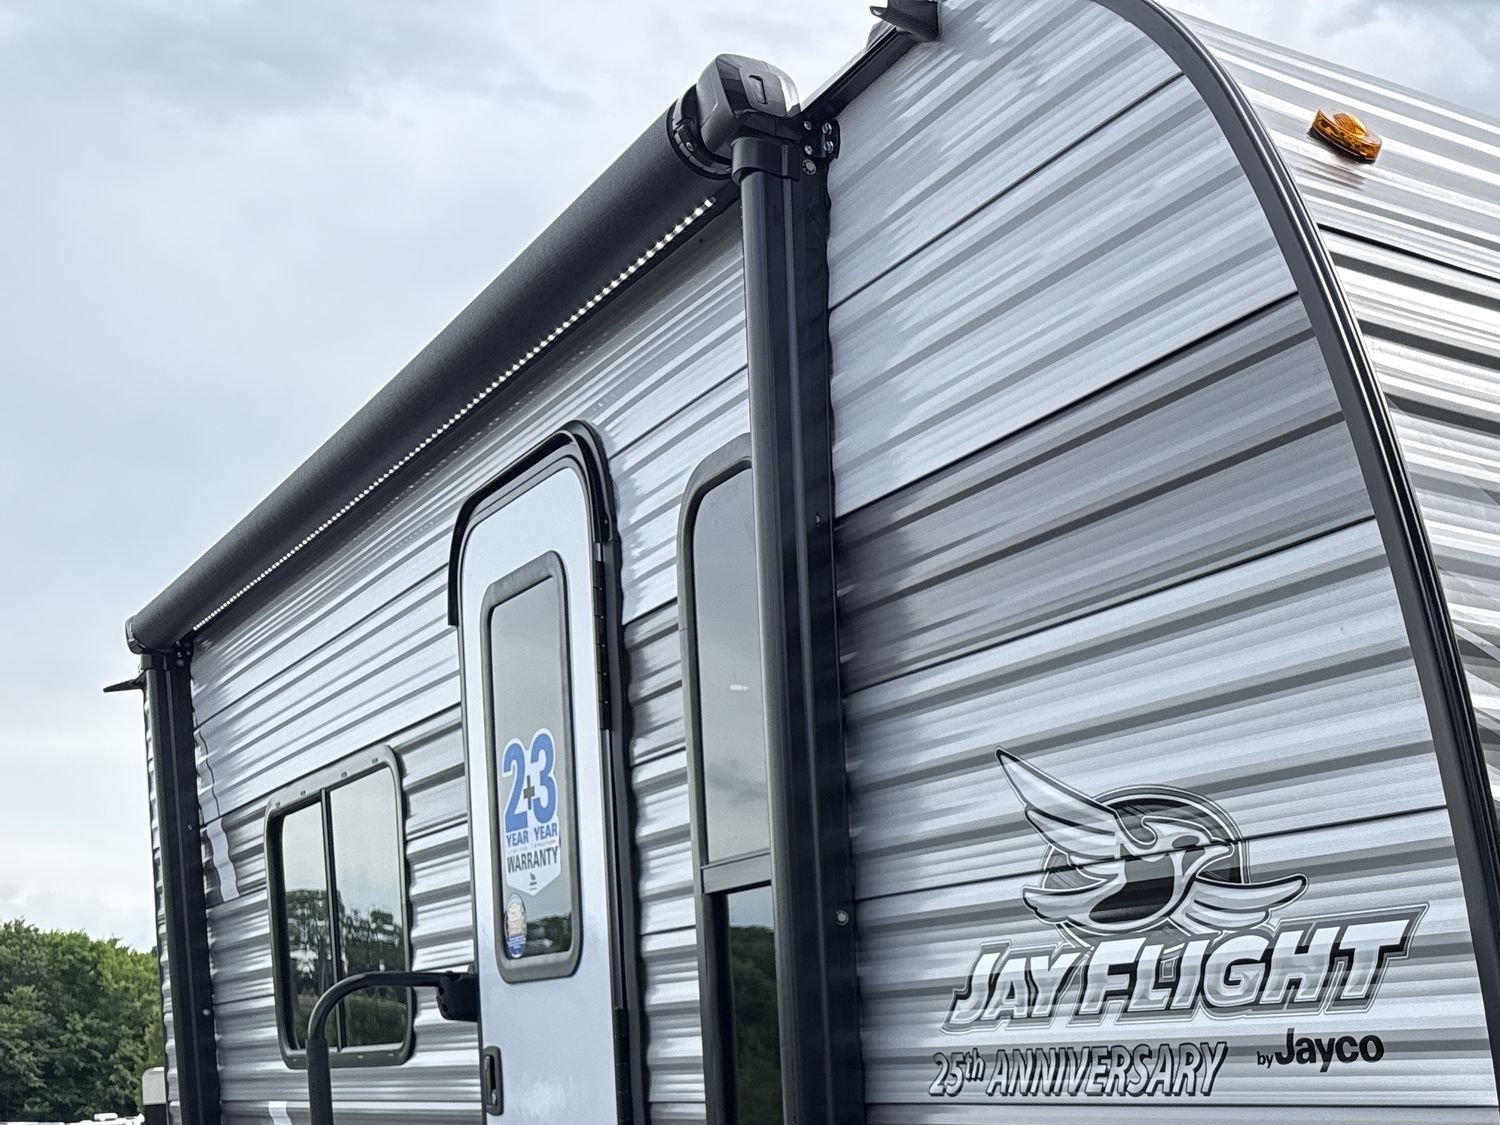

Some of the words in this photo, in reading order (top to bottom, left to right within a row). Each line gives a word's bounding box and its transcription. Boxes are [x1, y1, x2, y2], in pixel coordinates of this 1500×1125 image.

[506, 830, 529, 847] YEAR
[534, 822, 558, 841] YEAR
[506, 846, 559, 874] WARRANTY
[929, 1047, 985, 1096] 25th
[986, 1041, 1228, 1096] ANNIVERSARY
[1256, 1050, 1274, 1070] by
[1274, 1029, 1385, 1073] Jayco
